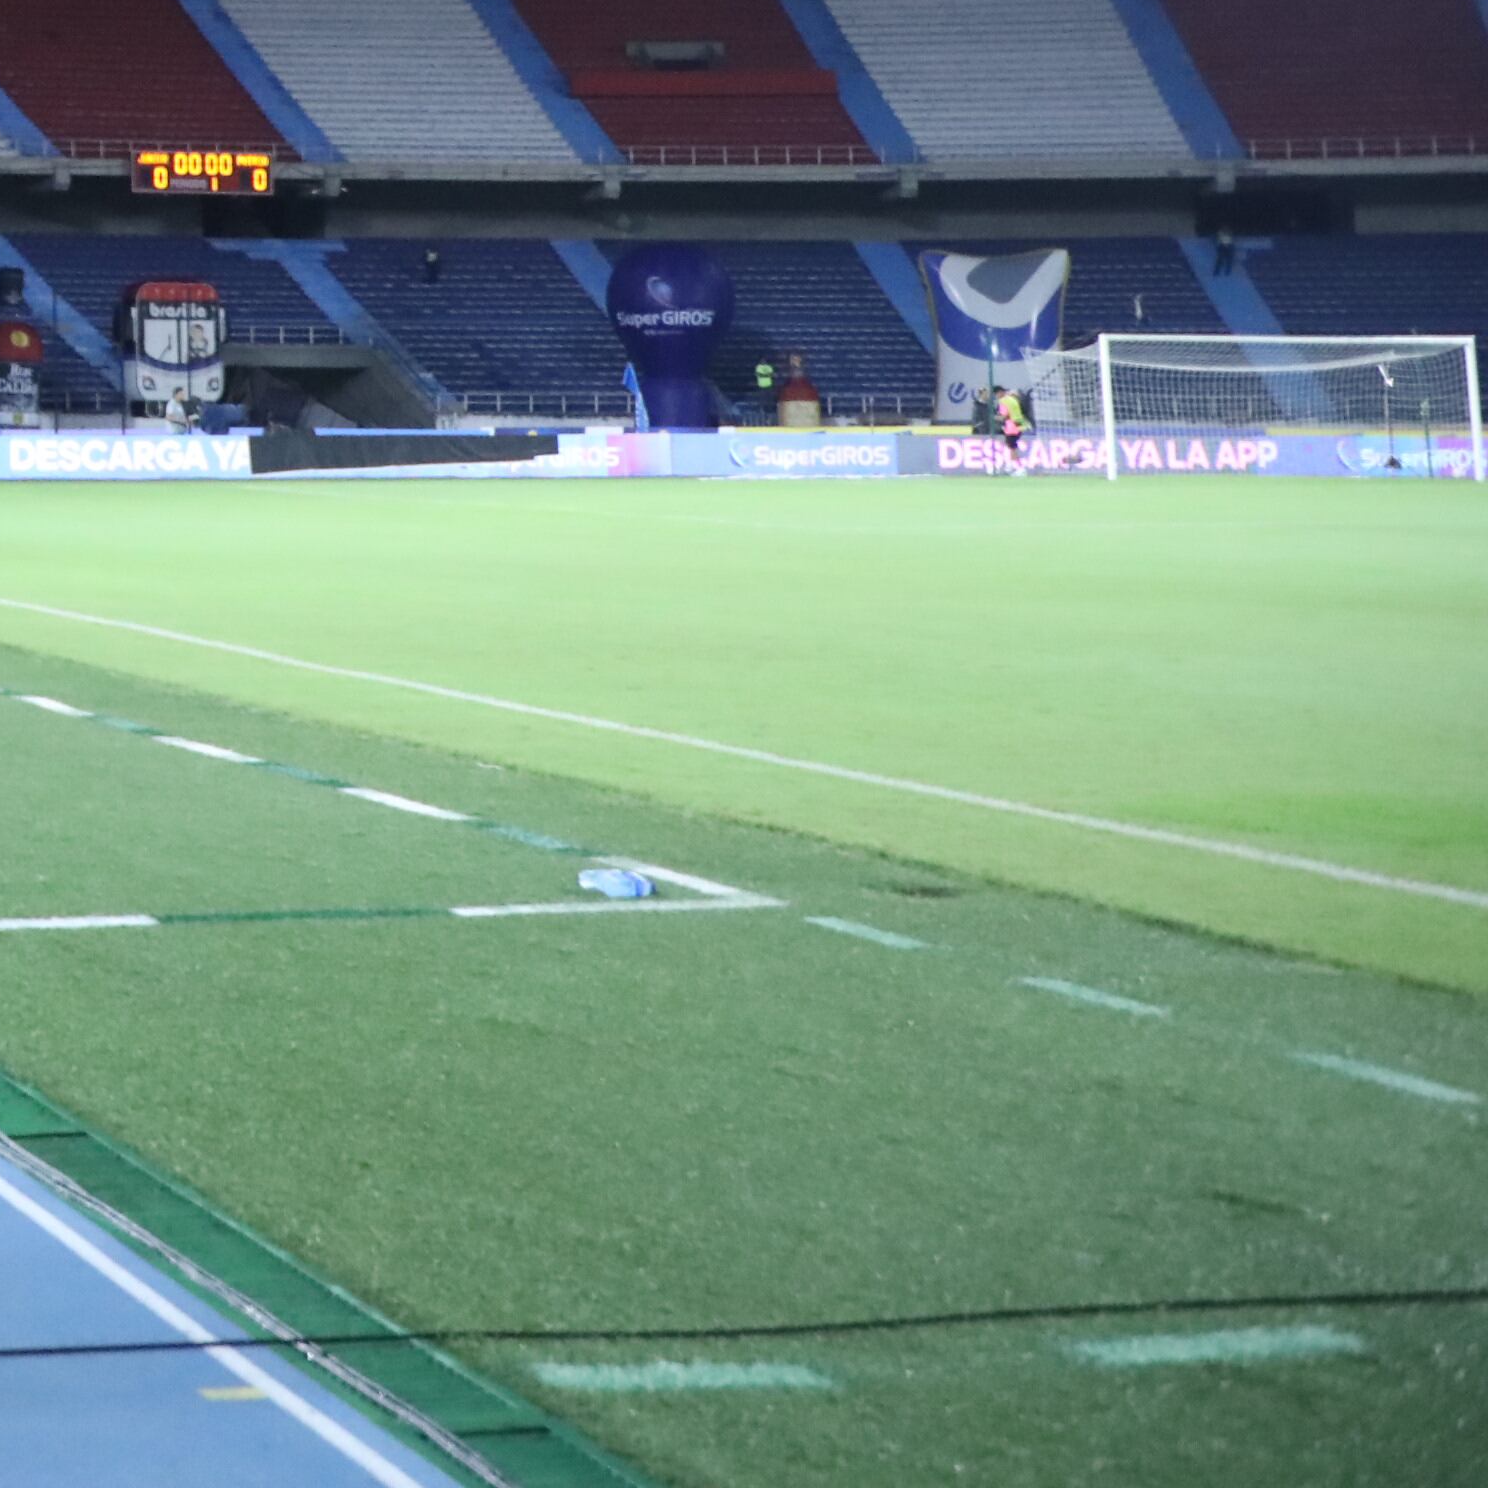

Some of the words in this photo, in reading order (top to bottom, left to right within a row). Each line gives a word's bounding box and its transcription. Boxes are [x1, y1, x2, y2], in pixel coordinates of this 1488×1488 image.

[153, 165, 168, 189] 0
[253, 168, 267, 191] 0
[9, 439, 208, 471] DESCARGA
[1120, 439, 1160, 469] YA
[1165, 439, 1209, 469] LA
[1216, 439, 1278, 469] APP
